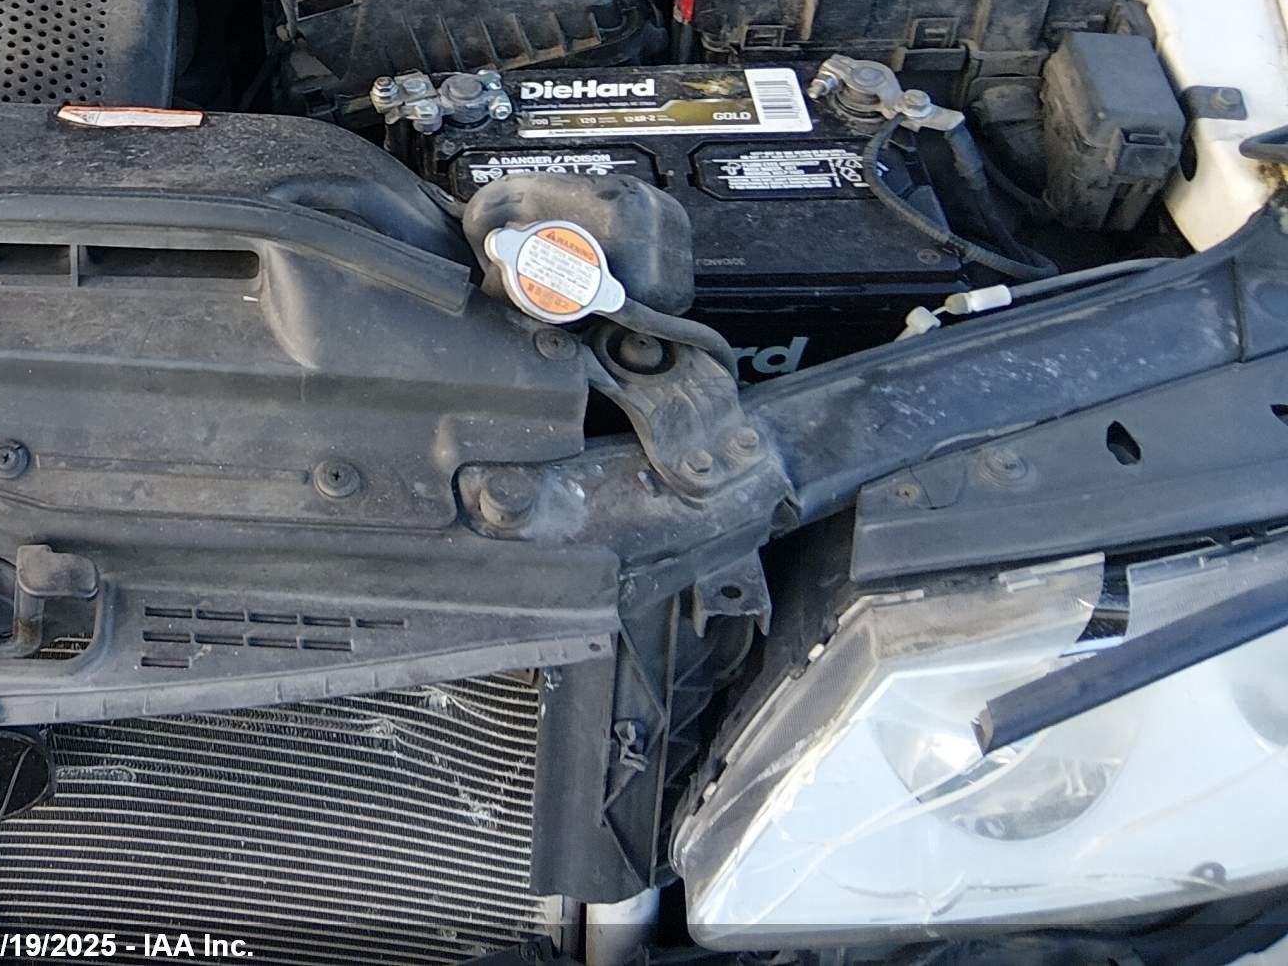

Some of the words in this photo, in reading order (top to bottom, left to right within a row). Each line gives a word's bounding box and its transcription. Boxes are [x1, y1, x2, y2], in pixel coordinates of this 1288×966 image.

[520, 78, 655, 100] DieHard
[712, 111, 752, 121] GOLD
[501, 156, 552, 165] DANGER
[564, 153, 611, 163] POISON
